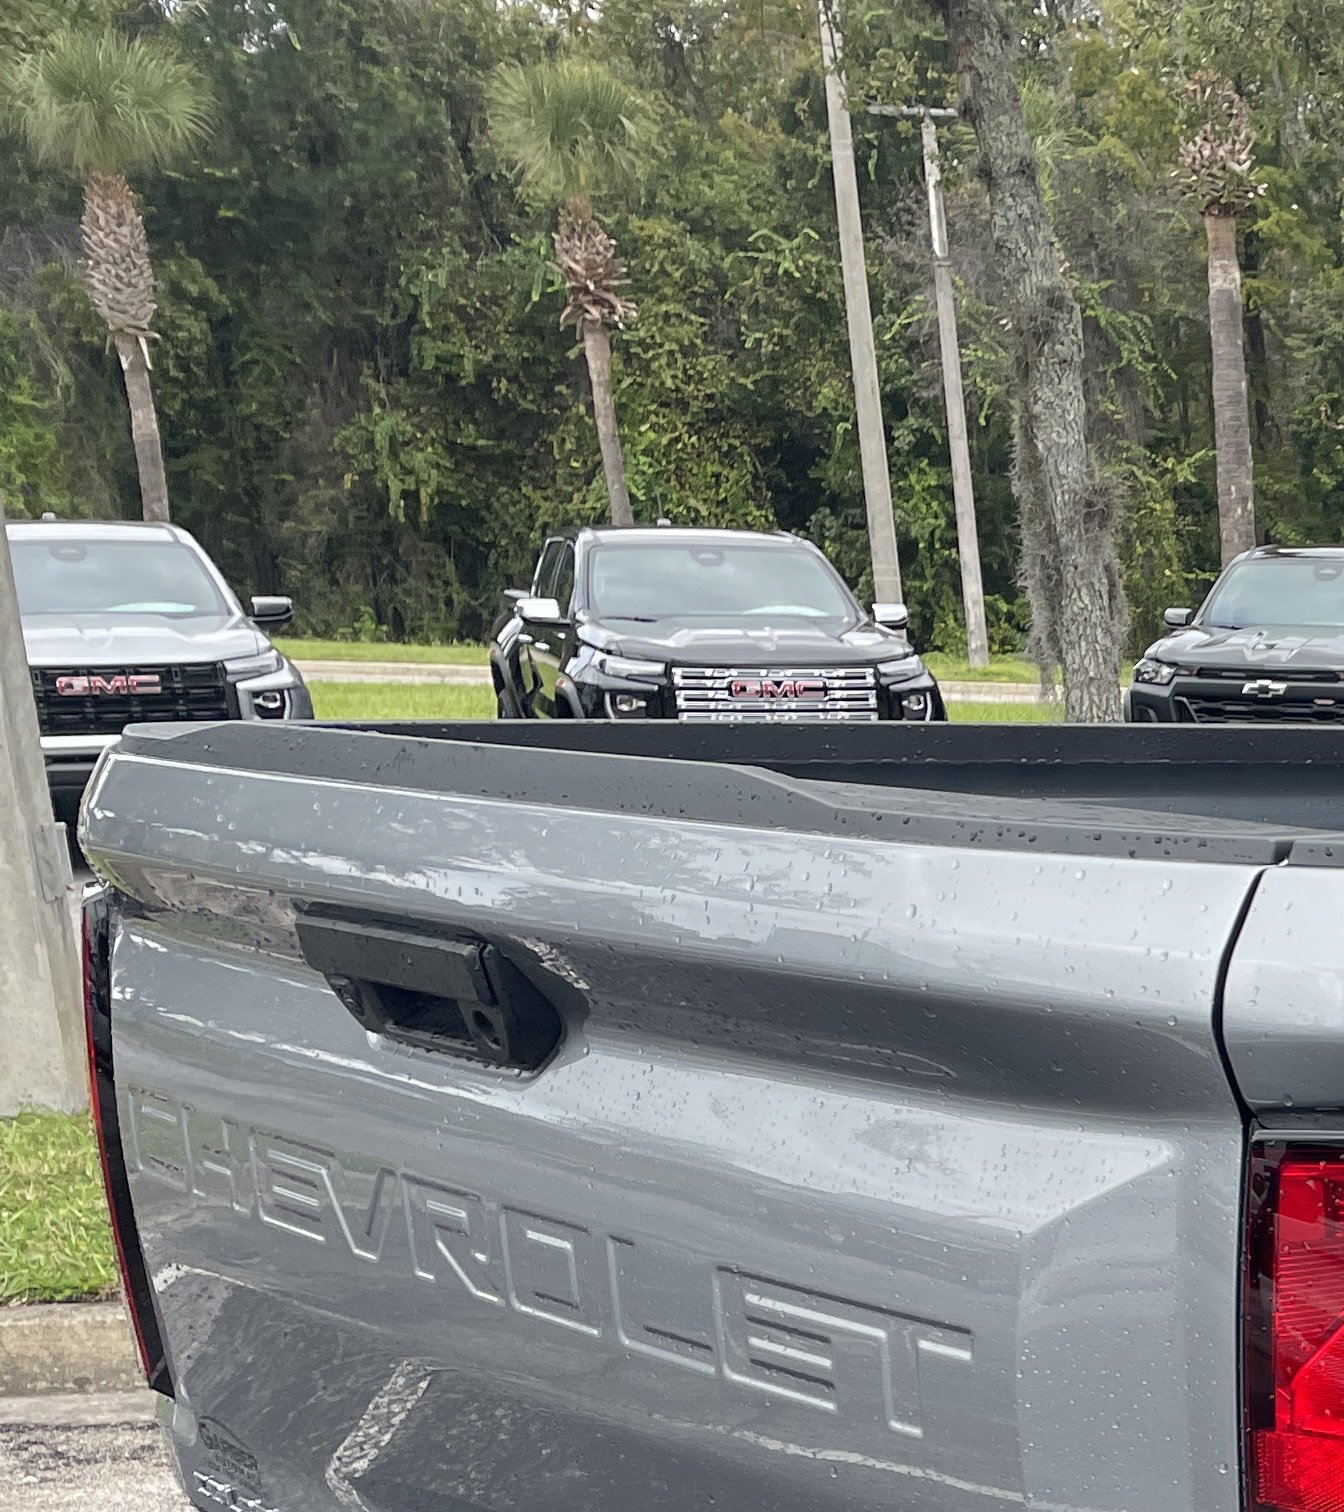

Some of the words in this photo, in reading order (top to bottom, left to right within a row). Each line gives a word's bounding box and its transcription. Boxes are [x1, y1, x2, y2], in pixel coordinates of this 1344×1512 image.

[55, 675, 161, 696] GMC
[731, 680, 825, 699] GMC
[127, 1084, 974, 1438] CHEVROLET
